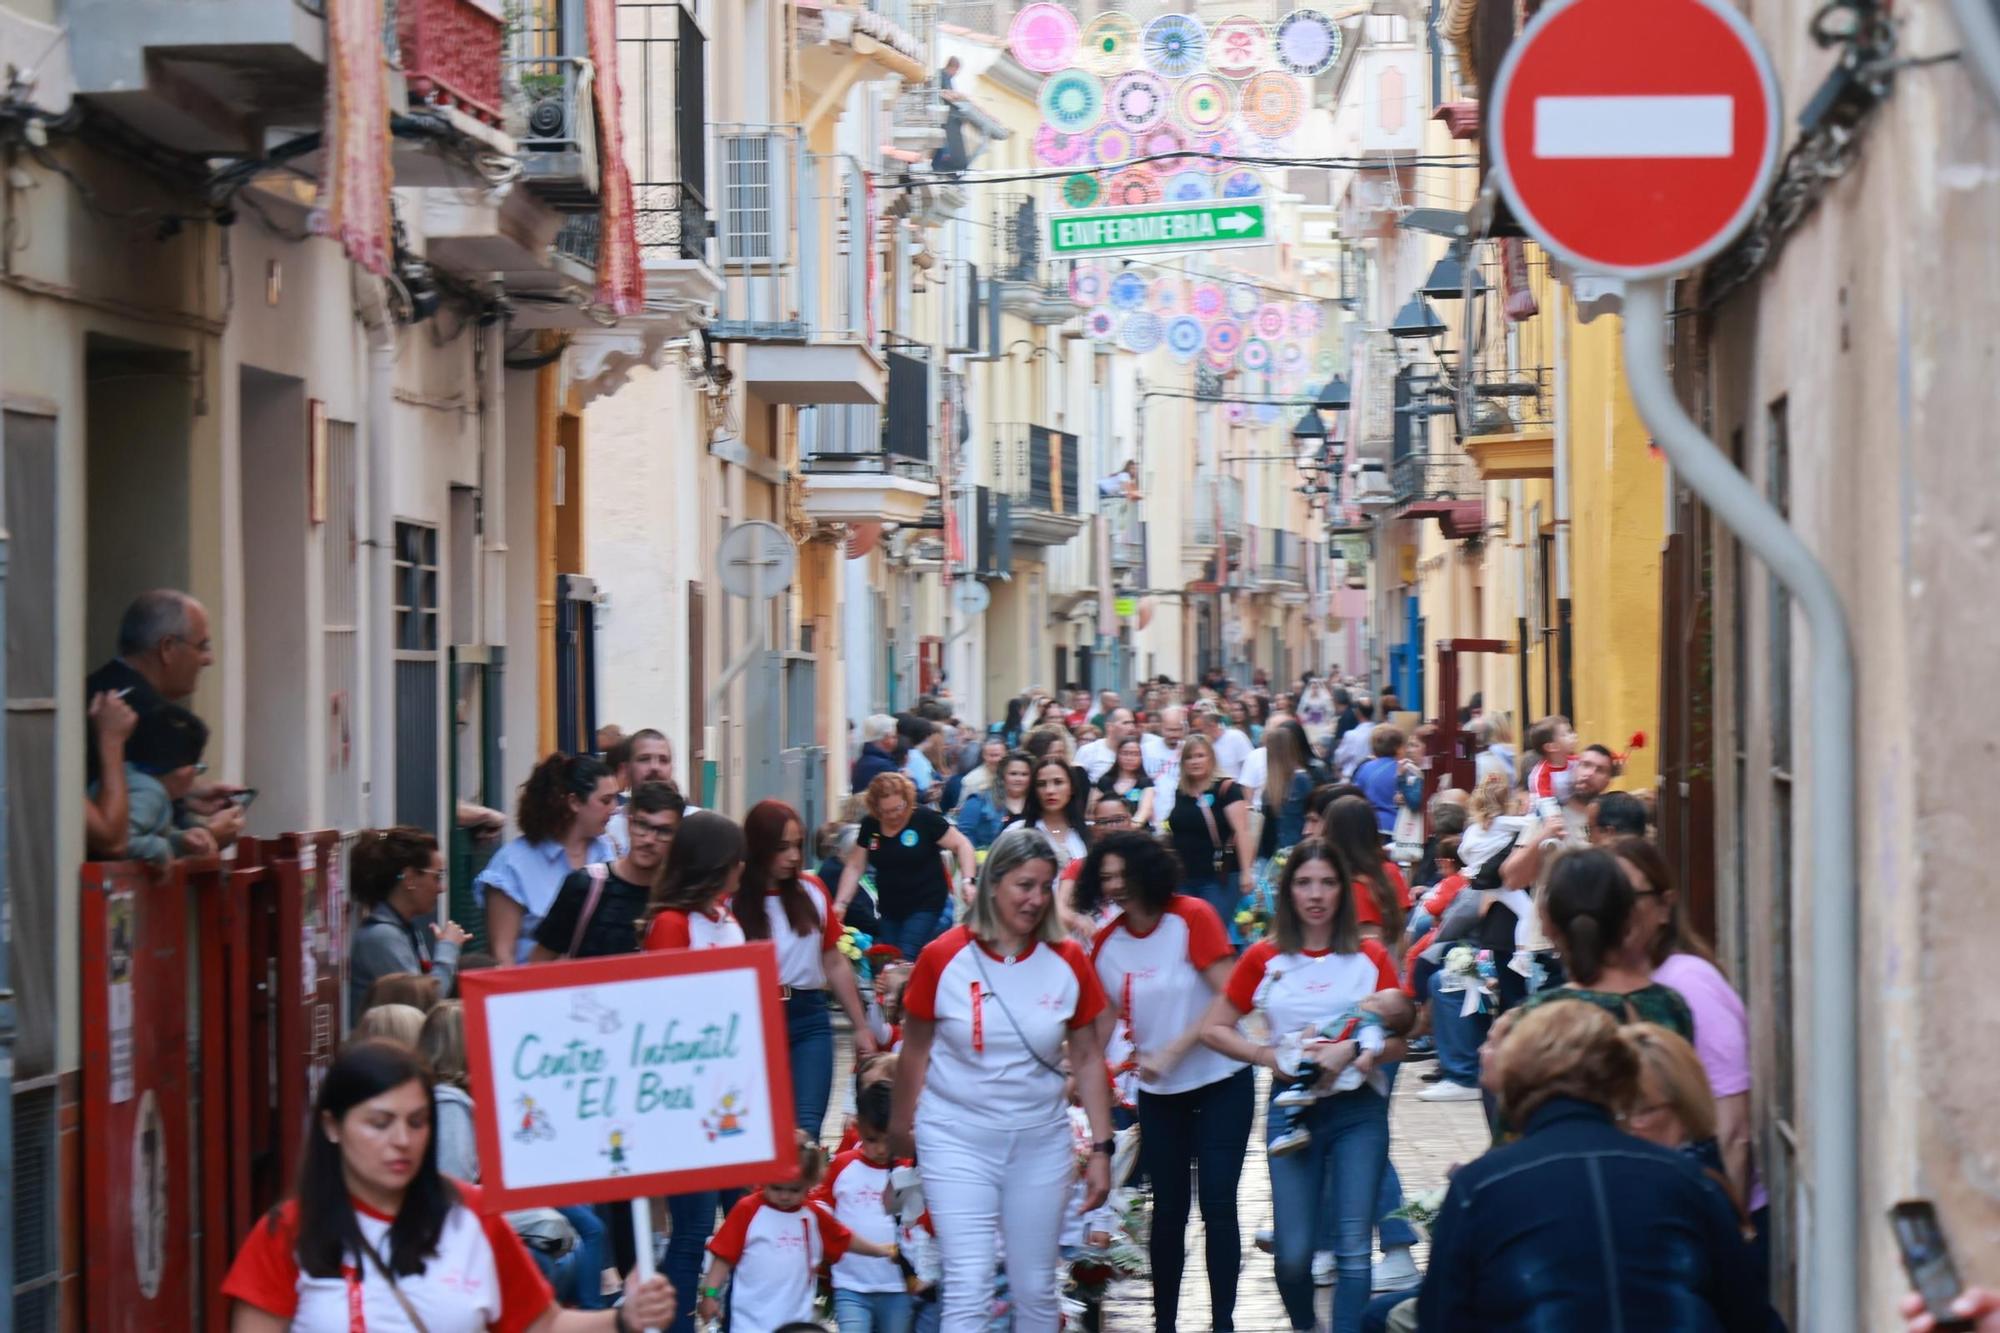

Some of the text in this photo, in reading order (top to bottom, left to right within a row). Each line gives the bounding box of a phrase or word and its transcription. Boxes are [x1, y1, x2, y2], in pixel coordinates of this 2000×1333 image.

[1058, 213, 1216, 247] ENFERMERIA
[513, 1013, 740, 1080] Centre Infantil
